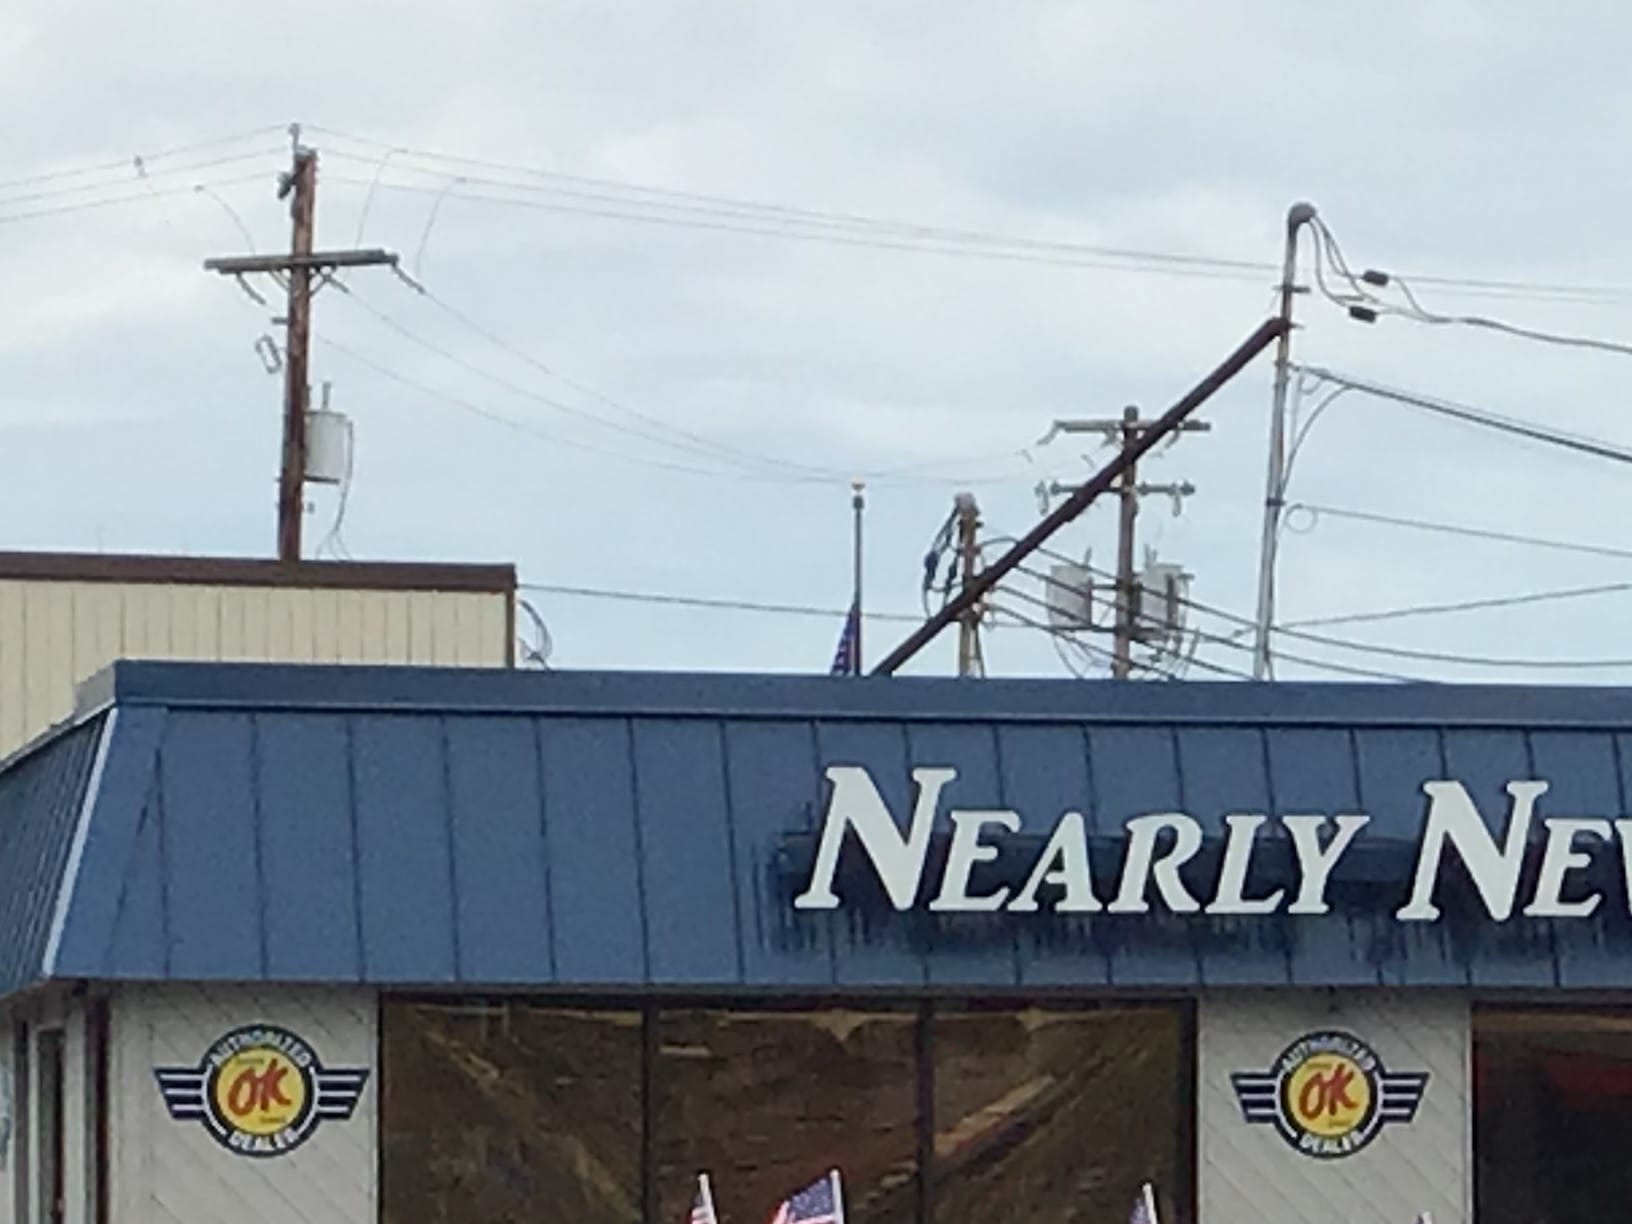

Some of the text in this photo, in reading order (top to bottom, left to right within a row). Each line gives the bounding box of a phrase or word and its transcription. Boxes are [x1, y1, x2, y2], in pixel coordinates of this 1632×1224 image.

[794, 767, 1370, 913] NEARLY
[228, 1058, 292, 1117] OK
[1298, 1063, 1359, 1121] OK
